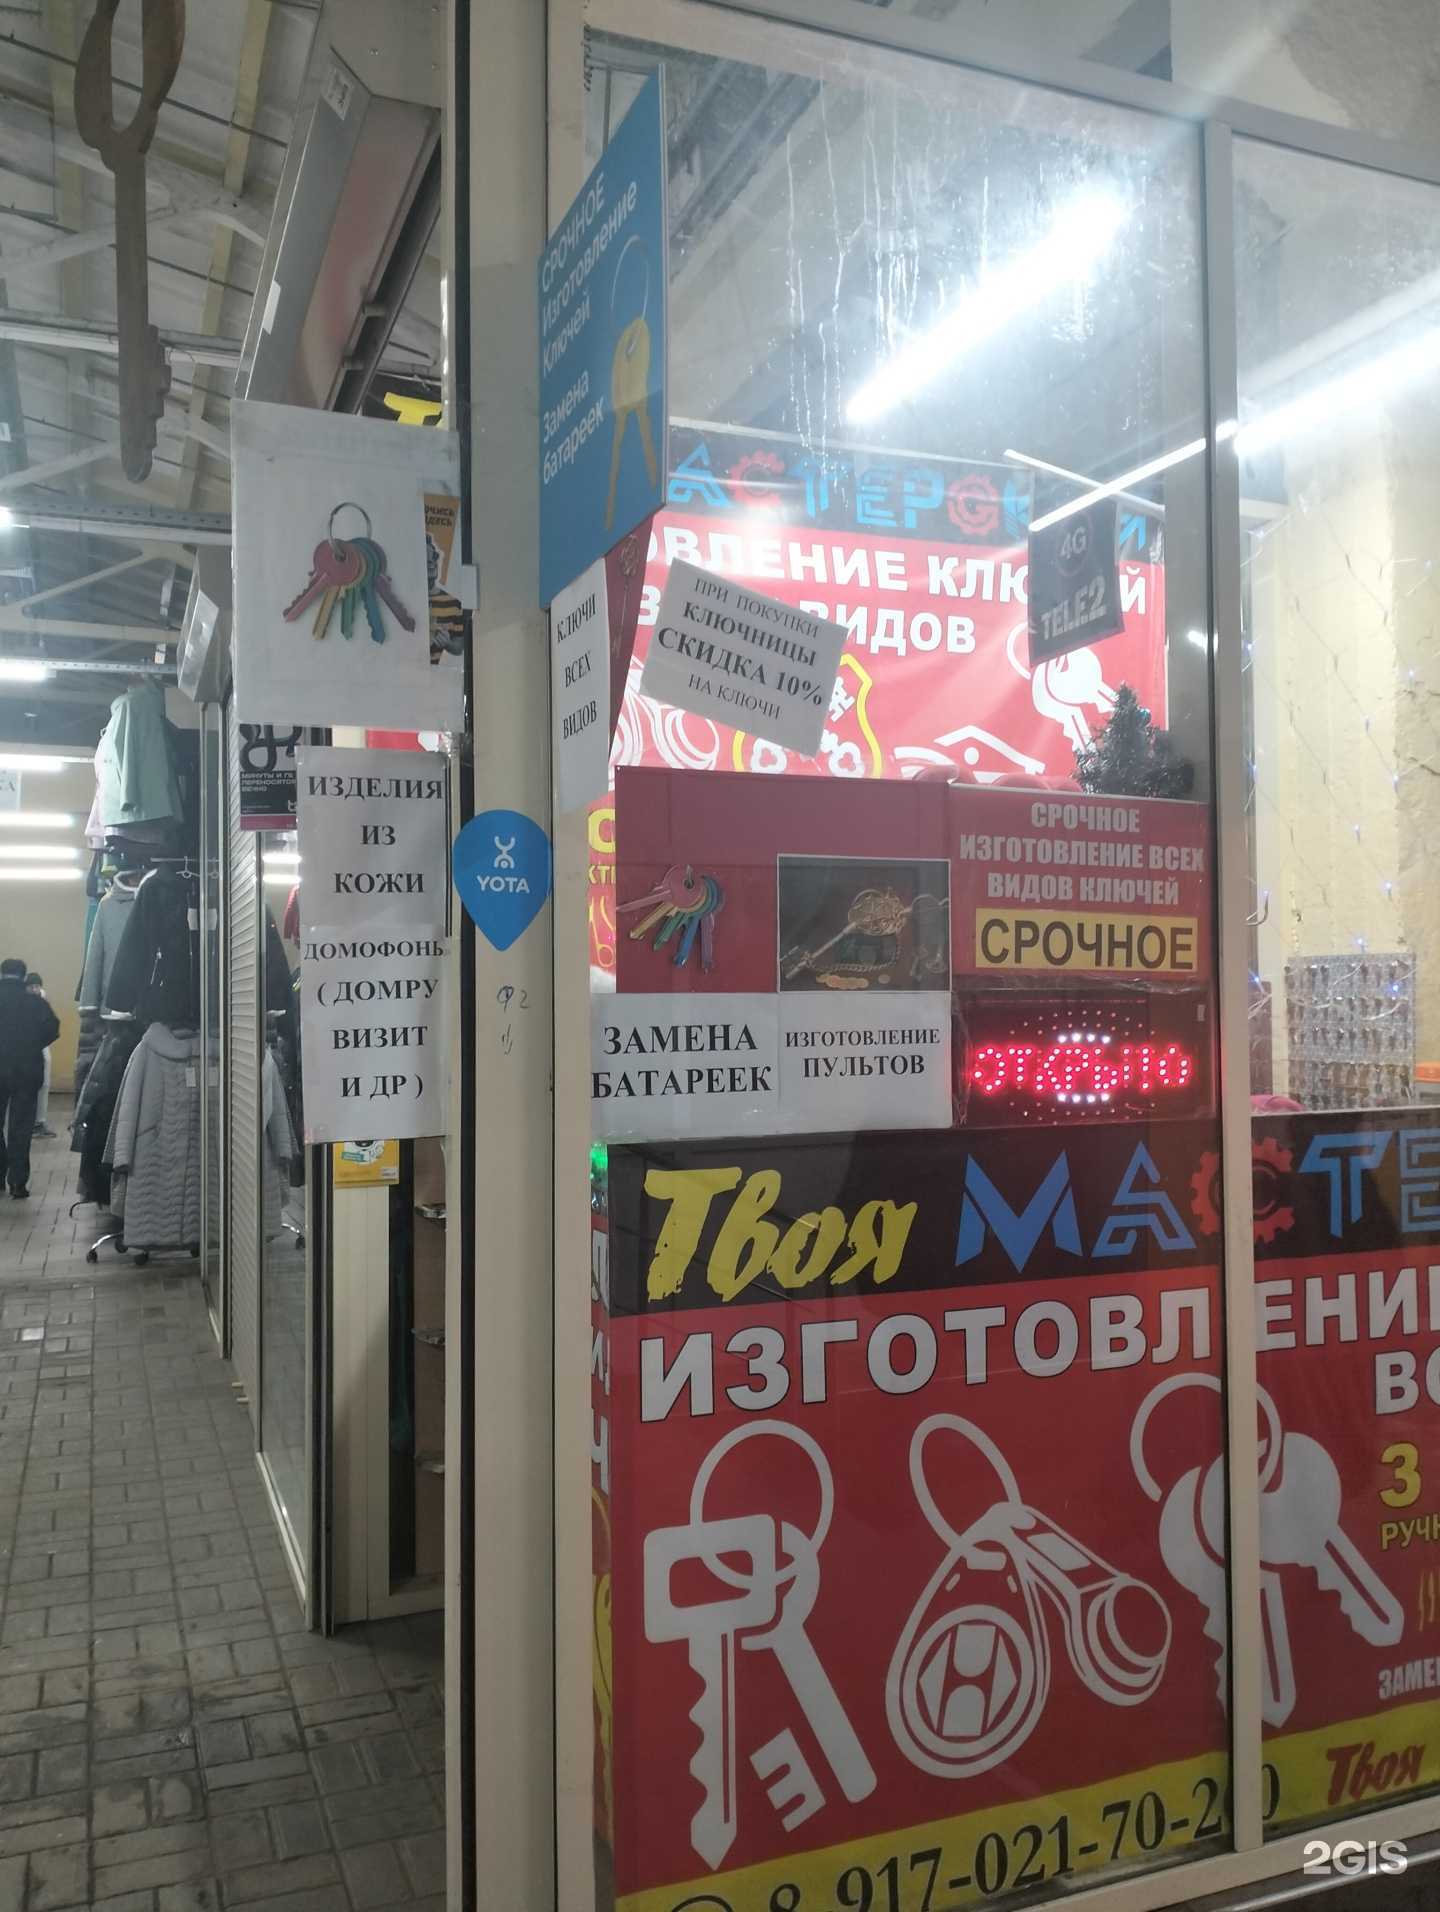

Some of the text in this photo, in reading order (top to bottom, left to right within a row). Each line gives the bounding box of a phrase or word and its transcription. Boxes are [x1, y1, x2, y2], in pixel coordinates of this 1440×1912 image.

[541, 172, 606, 293] СРОЧНОЕ
[543, 181, 638, 337] Изготовление
[543, 287, 591, 379] Ключей
[543, 370, 590, 444] Замена
[543, 394, 605, 486] батареек
[1060, 526, 1087, 560] 4G
[927, 554, 1146, 616] КЛЮЙ
[557, 593, 597, 644] КЛЮЧИ
[694, 578, 819, 639] ПРИ ПОКУПКИ
[1041, 575, 1107, 641] TELE2
[682, 601, 817, 667] КЛЮЧНИЦЫ
[564, 651, 592, 688] ВСЕХ
[657, 627, 823, 706] СКИДКА 10%
[688, 674, 782, 721] НА КЛЮЧИ
[562, 700, 598, 739] ВИДОВ
[308, 776, 444, 800] ИЗДЕЛИЯ
[360, 825, 396, 846] ИЗ
[1031, 801, 1141, 834] СРОЧНОЕ
[959, 833, 1205, 873] ИЗГОТОВЛЕНИЕ ВСЕХ
[334, 873, 425, 893] КОЖИ
[476, 874, 531, 894] YOTA
[987, 872, 1180, 906] ВИДОВ КЛЮЧЕЙ
[980, 917, 1194, 970] СРОЧНОЕ
[333, 1026, 428, 1049] ВИЗИТ
[603, 1024, 759, 1055] ЗАМЕНА
[785, 1029, 941, 1048] ИЗГОТОВЛЕНИЕ
[341, 1076, 361, 1098] И
[591, 1066, 773, 1099] БАТАРЕЕК
[803, 1054, 925, 1078] ПУЛЬТОВ
[644, 1167, 917, 1302] Твоя
[640, 1265, 1440, 1423] ИЗГОТОВЛЕНИ
[1326, 1741, 1426, 1805] Твоя
